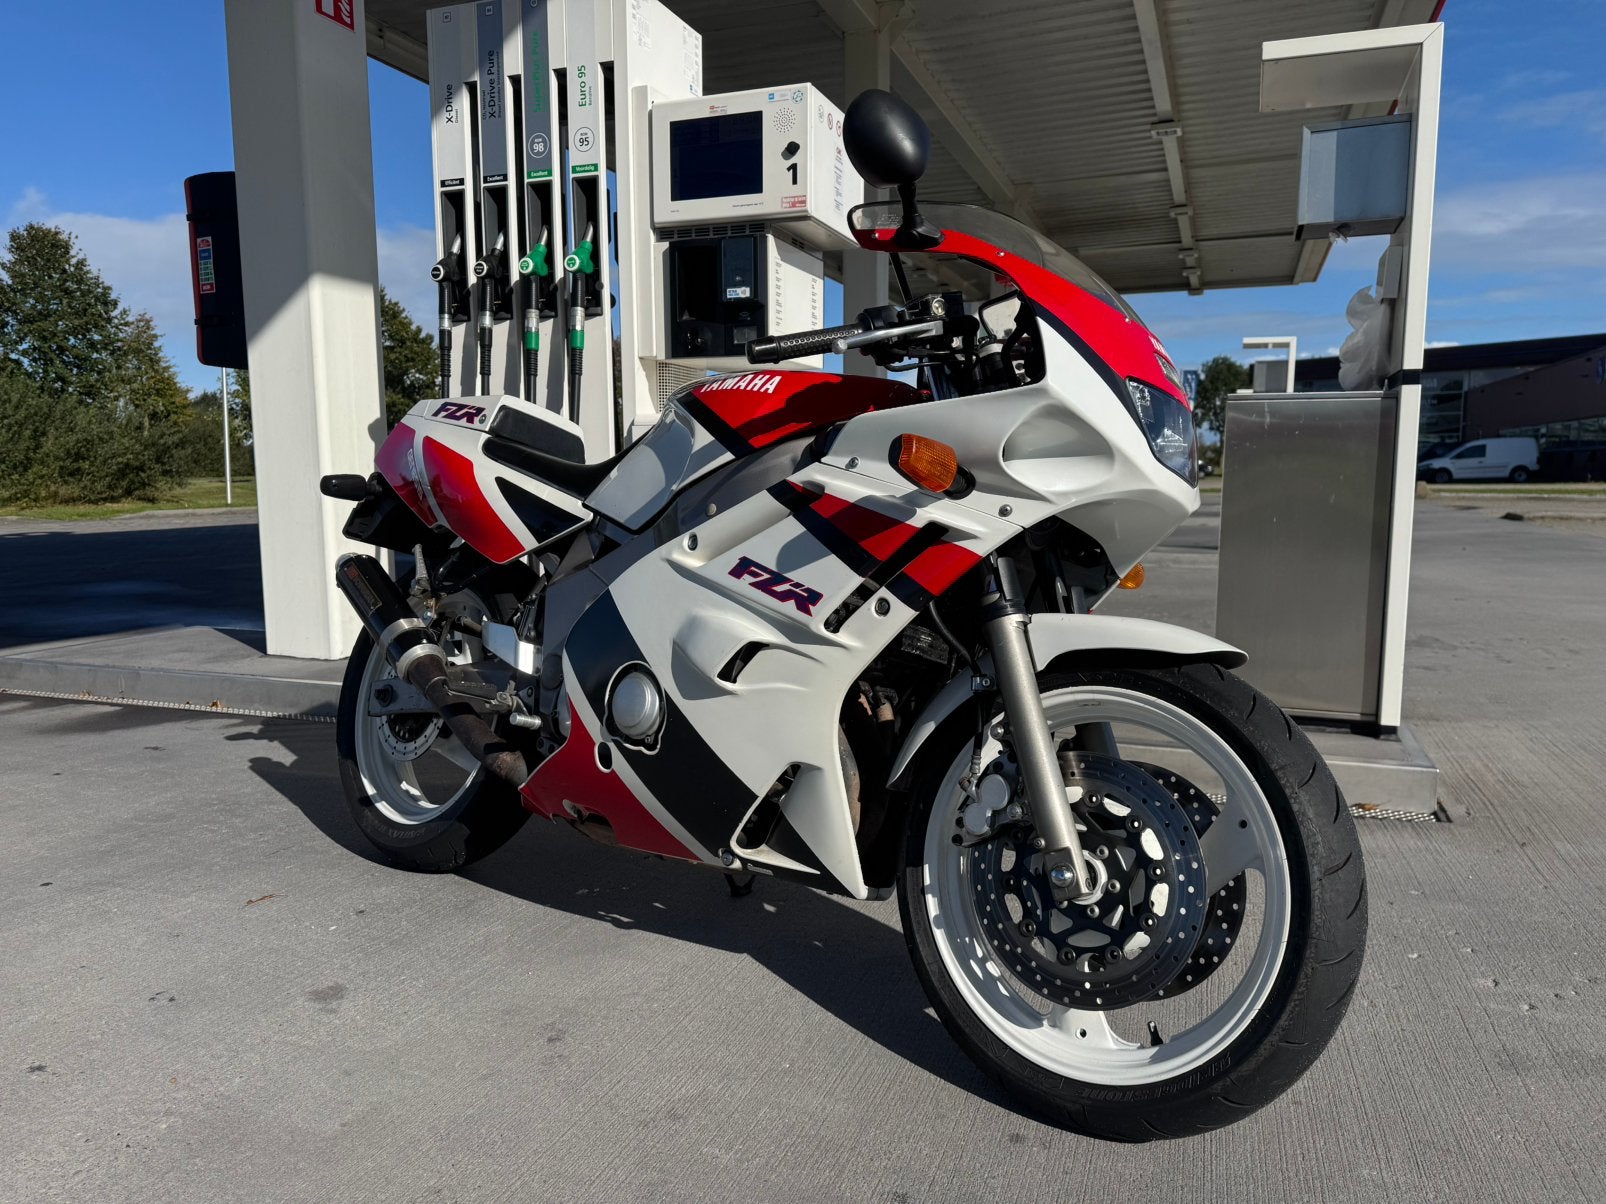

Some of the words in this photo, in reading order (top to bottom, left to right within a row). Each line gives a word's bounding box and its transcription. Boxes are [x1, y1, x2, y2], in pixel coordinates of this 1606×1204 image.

[486, 50, 495, 75] Pure
[577, 65, 586, 79] 95
[445, 84, 454, 124] X-Drive
[487, 78, 496, 119] X-Drive
[578, 82, 587, 107] Euro
[533, 142, 544, 153] 98
[578, 137, 590, 147] 95
[786, 163, 798, 186] 1
[700, 374, 783, 394] YAMAHA
[431, 401, 486, 425] FZR
[727, 555, 824, 618] FZR
